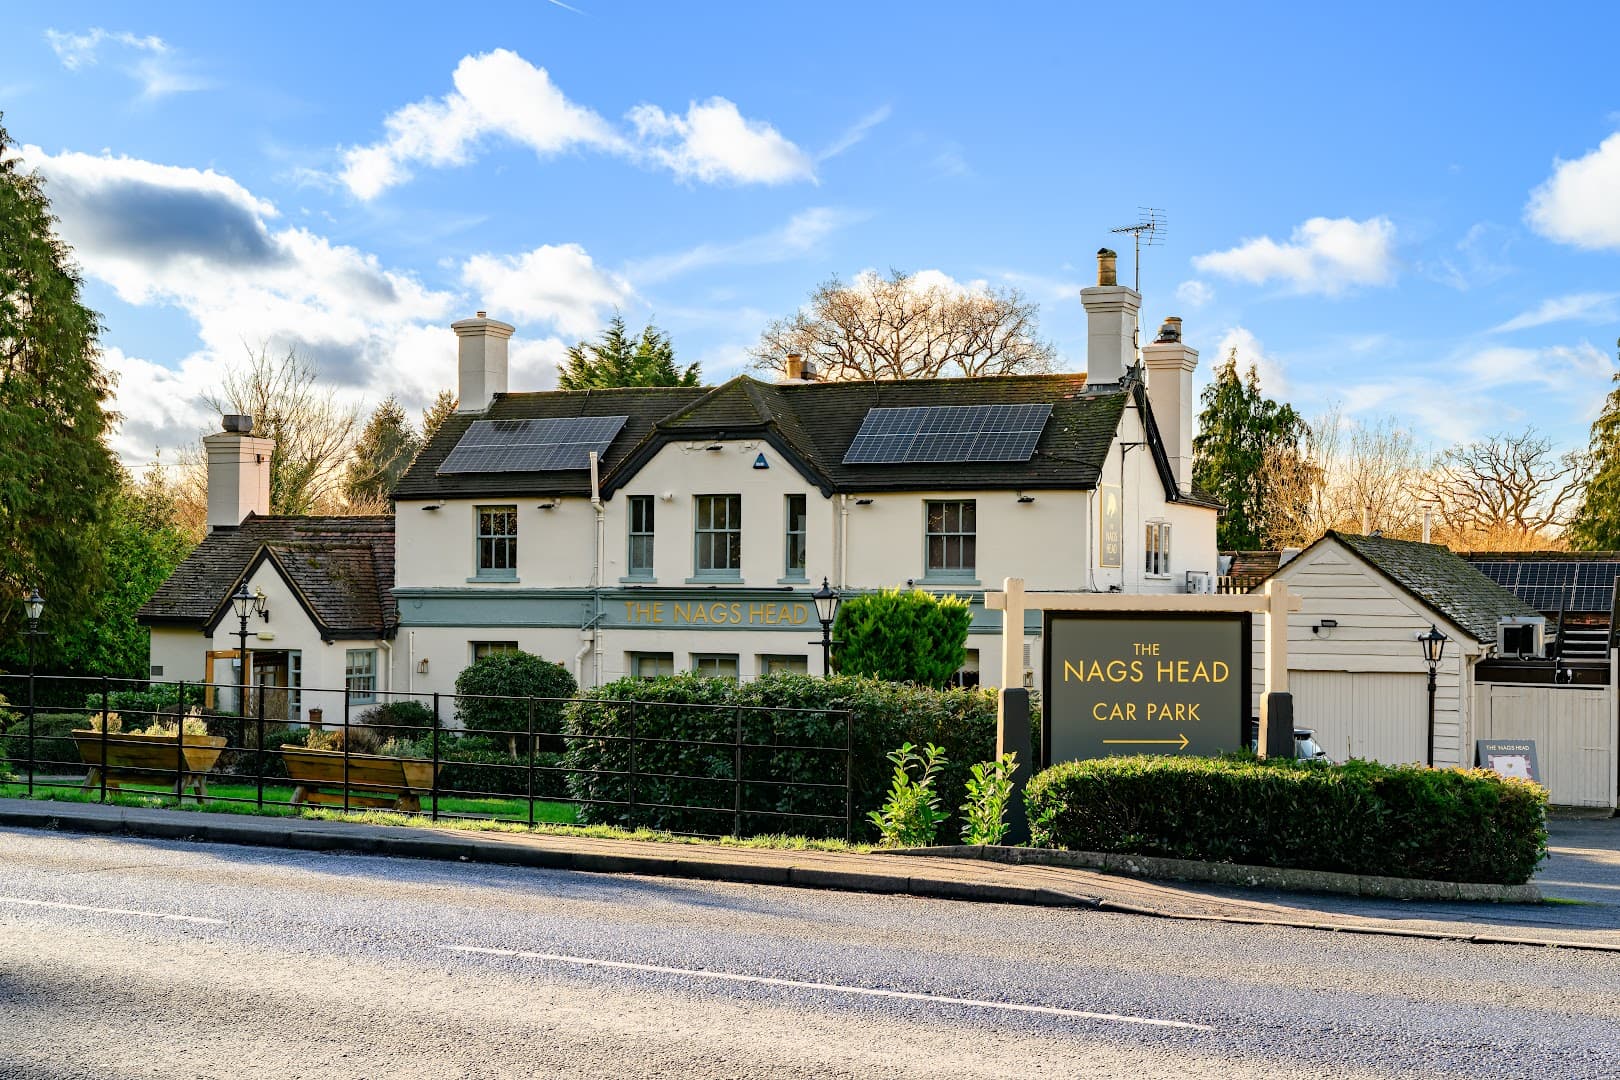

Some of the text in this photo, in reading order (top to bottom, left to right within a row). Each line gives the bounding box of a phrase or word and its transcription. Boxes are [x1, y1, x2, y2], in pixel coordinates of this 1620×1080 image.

[624, 601, 809, 625] THE NAGS HEAD
[1133, 643, 1160, 656] THE
[1064, 660, 1230, 683] NAGS HEAD
[1092, 703, 1201, 721] CAR PARK
